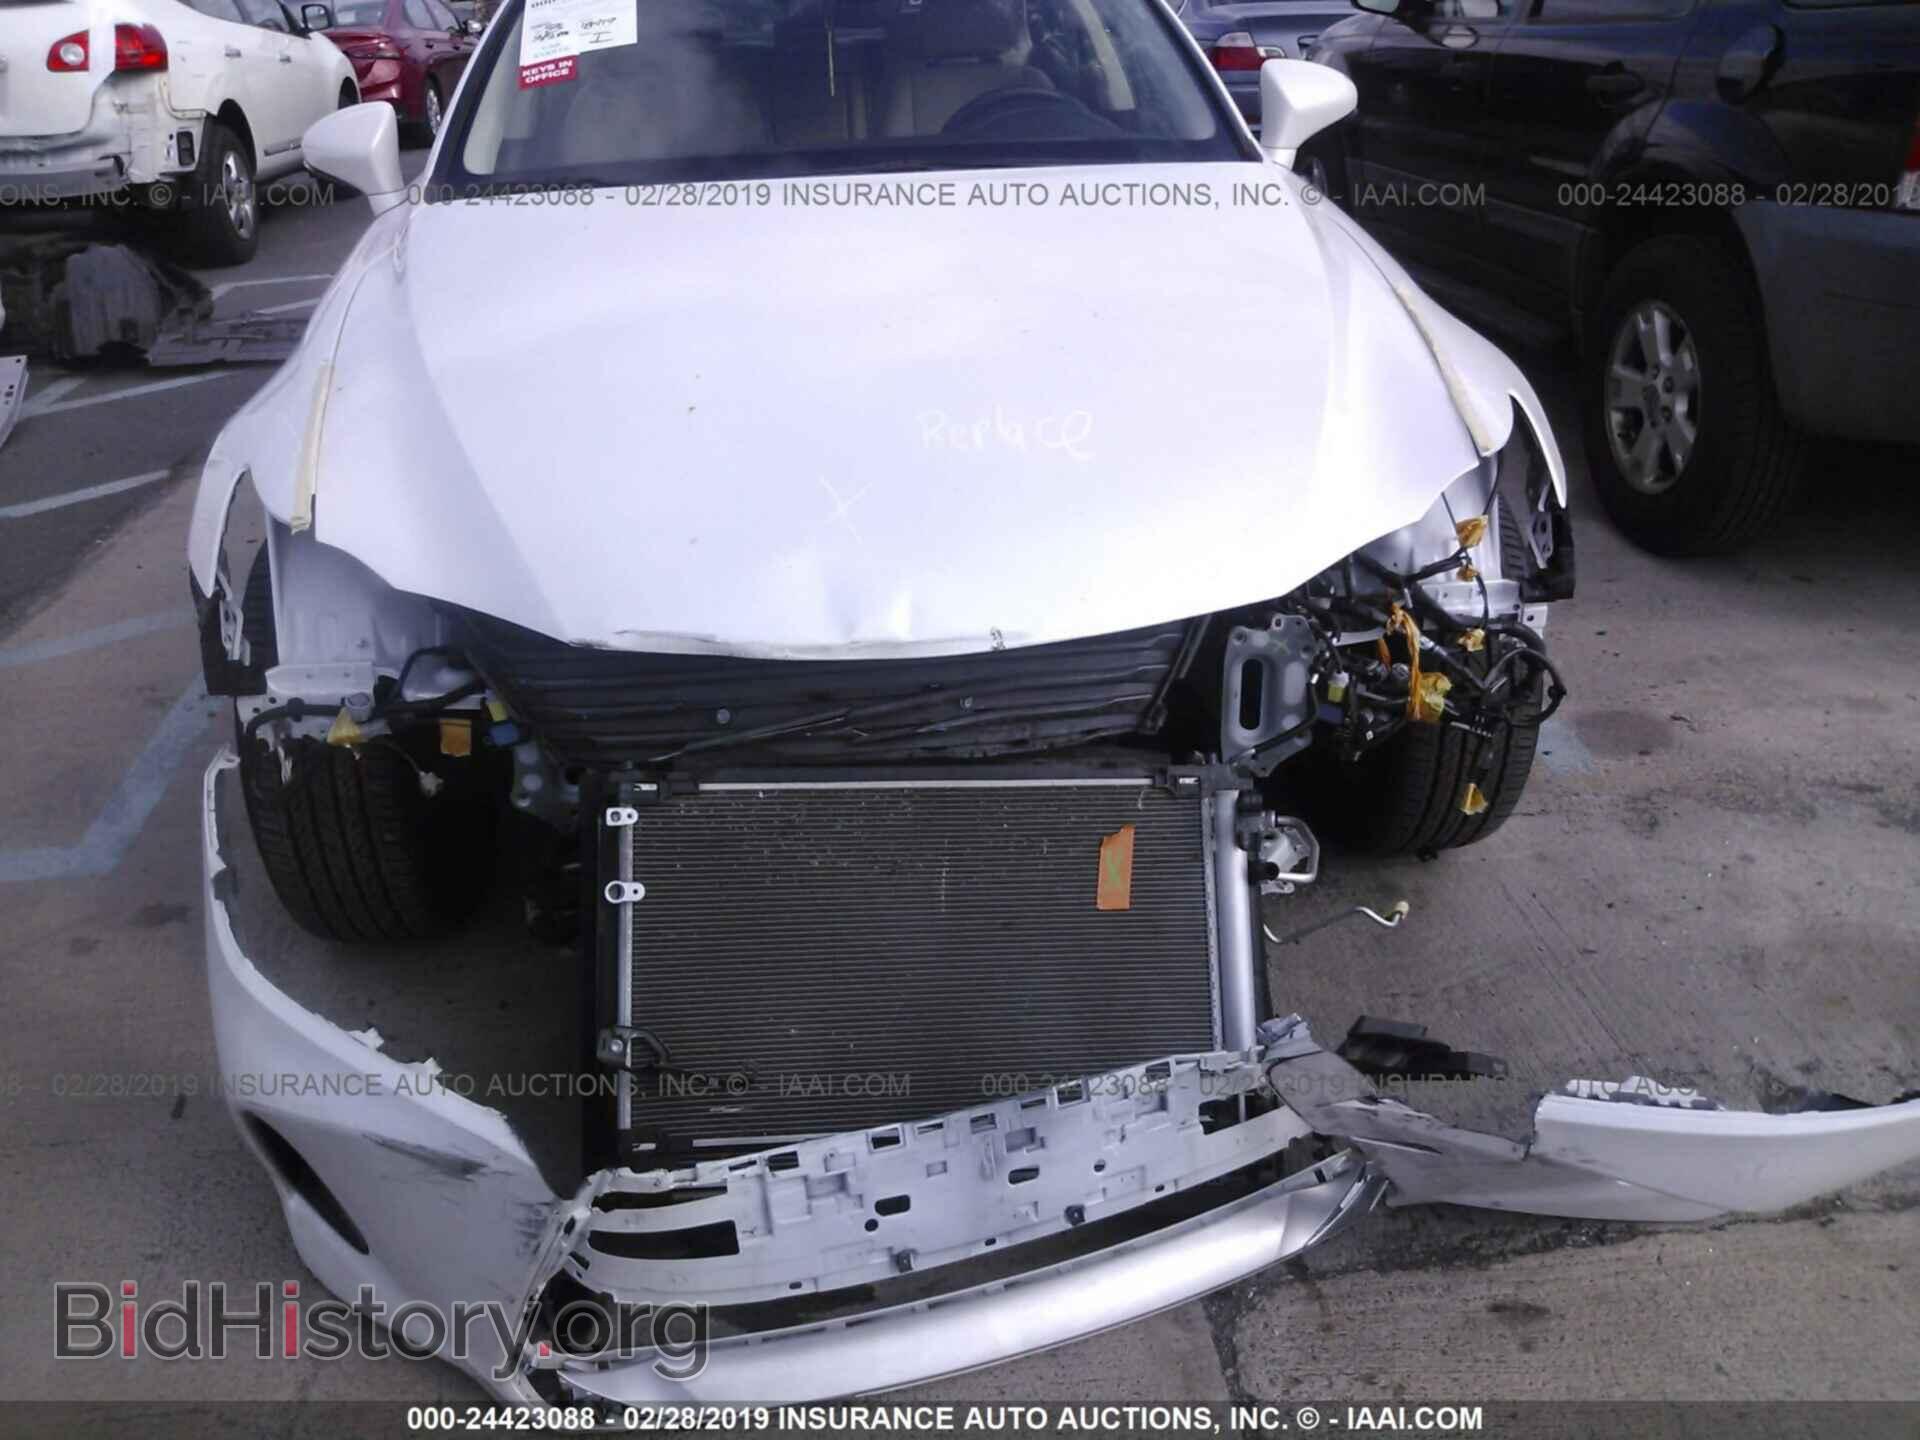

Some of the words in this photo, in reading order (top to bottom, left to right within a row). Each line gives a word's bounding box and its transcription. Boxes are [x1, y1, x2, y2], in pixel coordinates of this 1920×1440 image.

[522, 63, 556, 78] KEYS
[558, 59, 574, 68] IN
[525, 67, 570, 84] OFFICE
